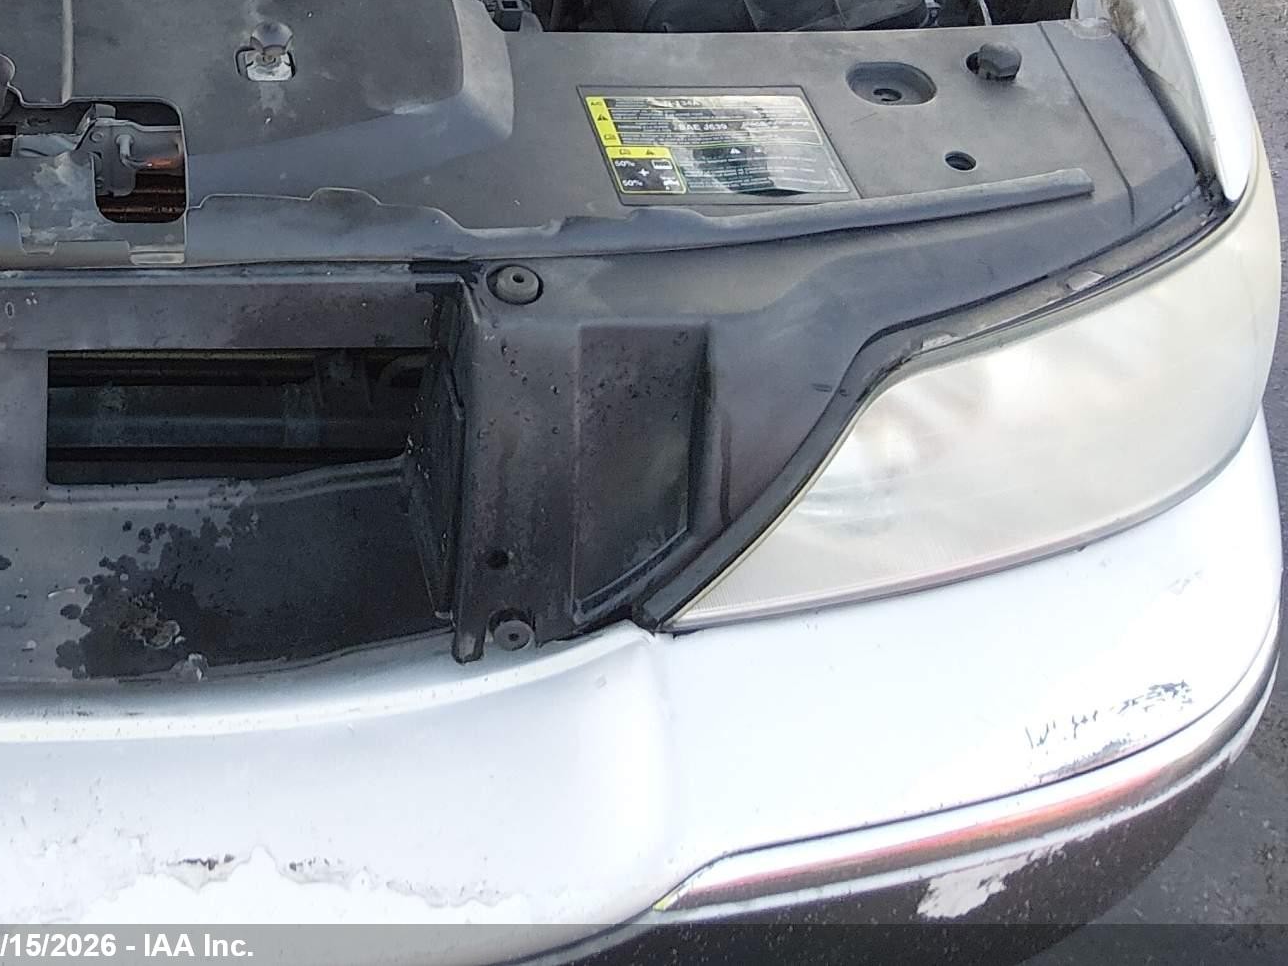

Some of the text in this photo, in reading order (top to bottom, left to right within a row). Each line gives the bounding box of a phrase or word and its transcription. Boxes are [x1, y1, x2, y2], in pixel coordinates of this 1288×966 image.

[678, 123, 701, 131] SAE
[703, 122, 728, 131] J639
[622, 179, 644, 187] 50%
